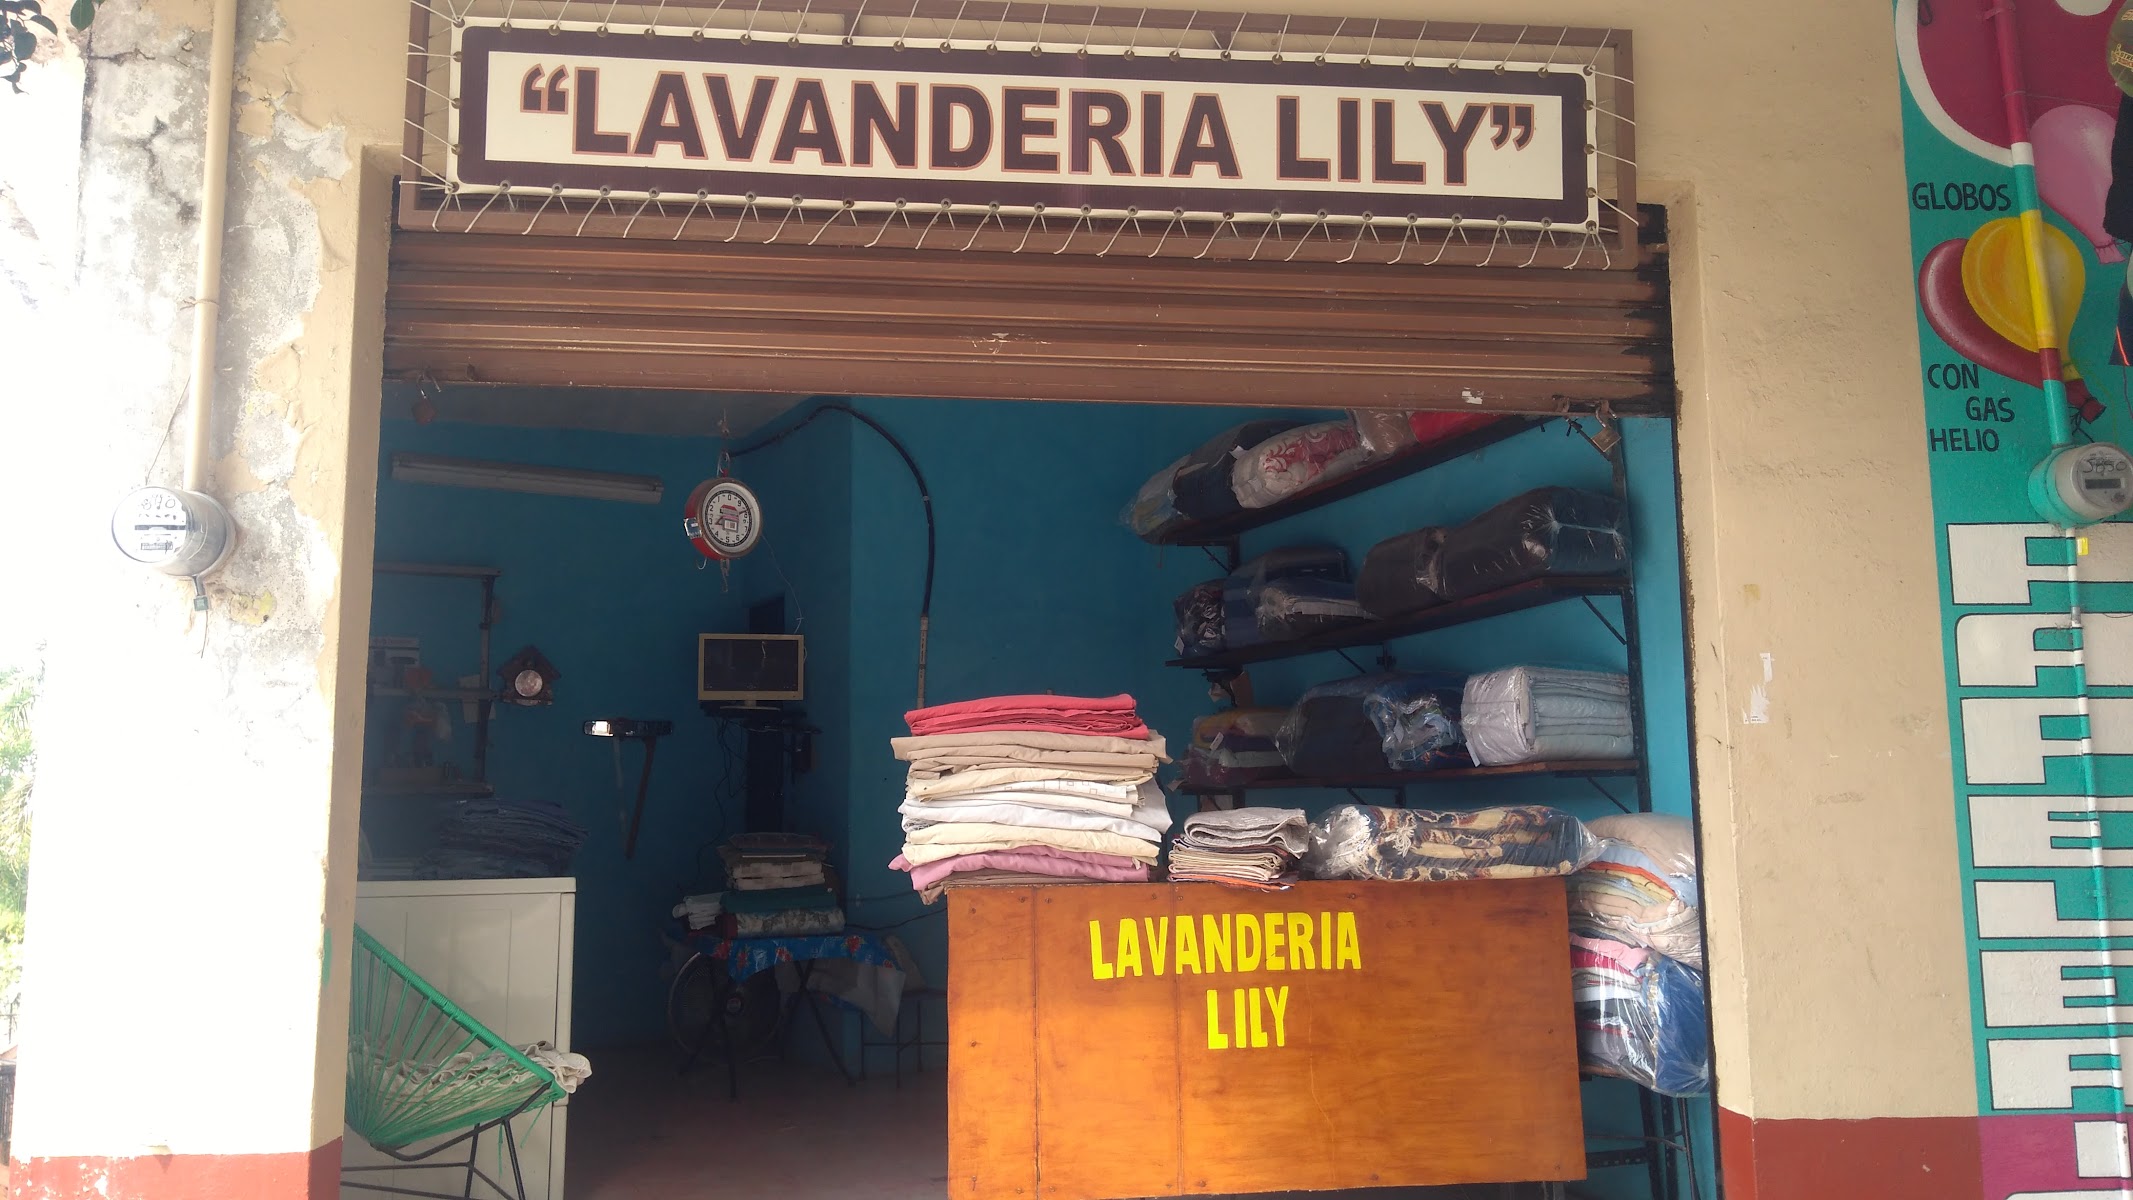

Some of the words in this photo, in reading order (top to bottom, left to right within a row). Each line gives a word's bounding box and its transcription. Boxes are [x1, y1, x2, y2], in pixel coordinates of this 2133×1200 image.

[1912, 182, 2012, 212] GLOBOS
[1927, 363, 1980, 391] CON
[1965, 396, 2016, 423] GAS
[1929, 428, 2000, 452] HELIO
[1089, 911, 1362, 980] LAVANDERIA
[1206, 986, 1289, 1050] LILY
